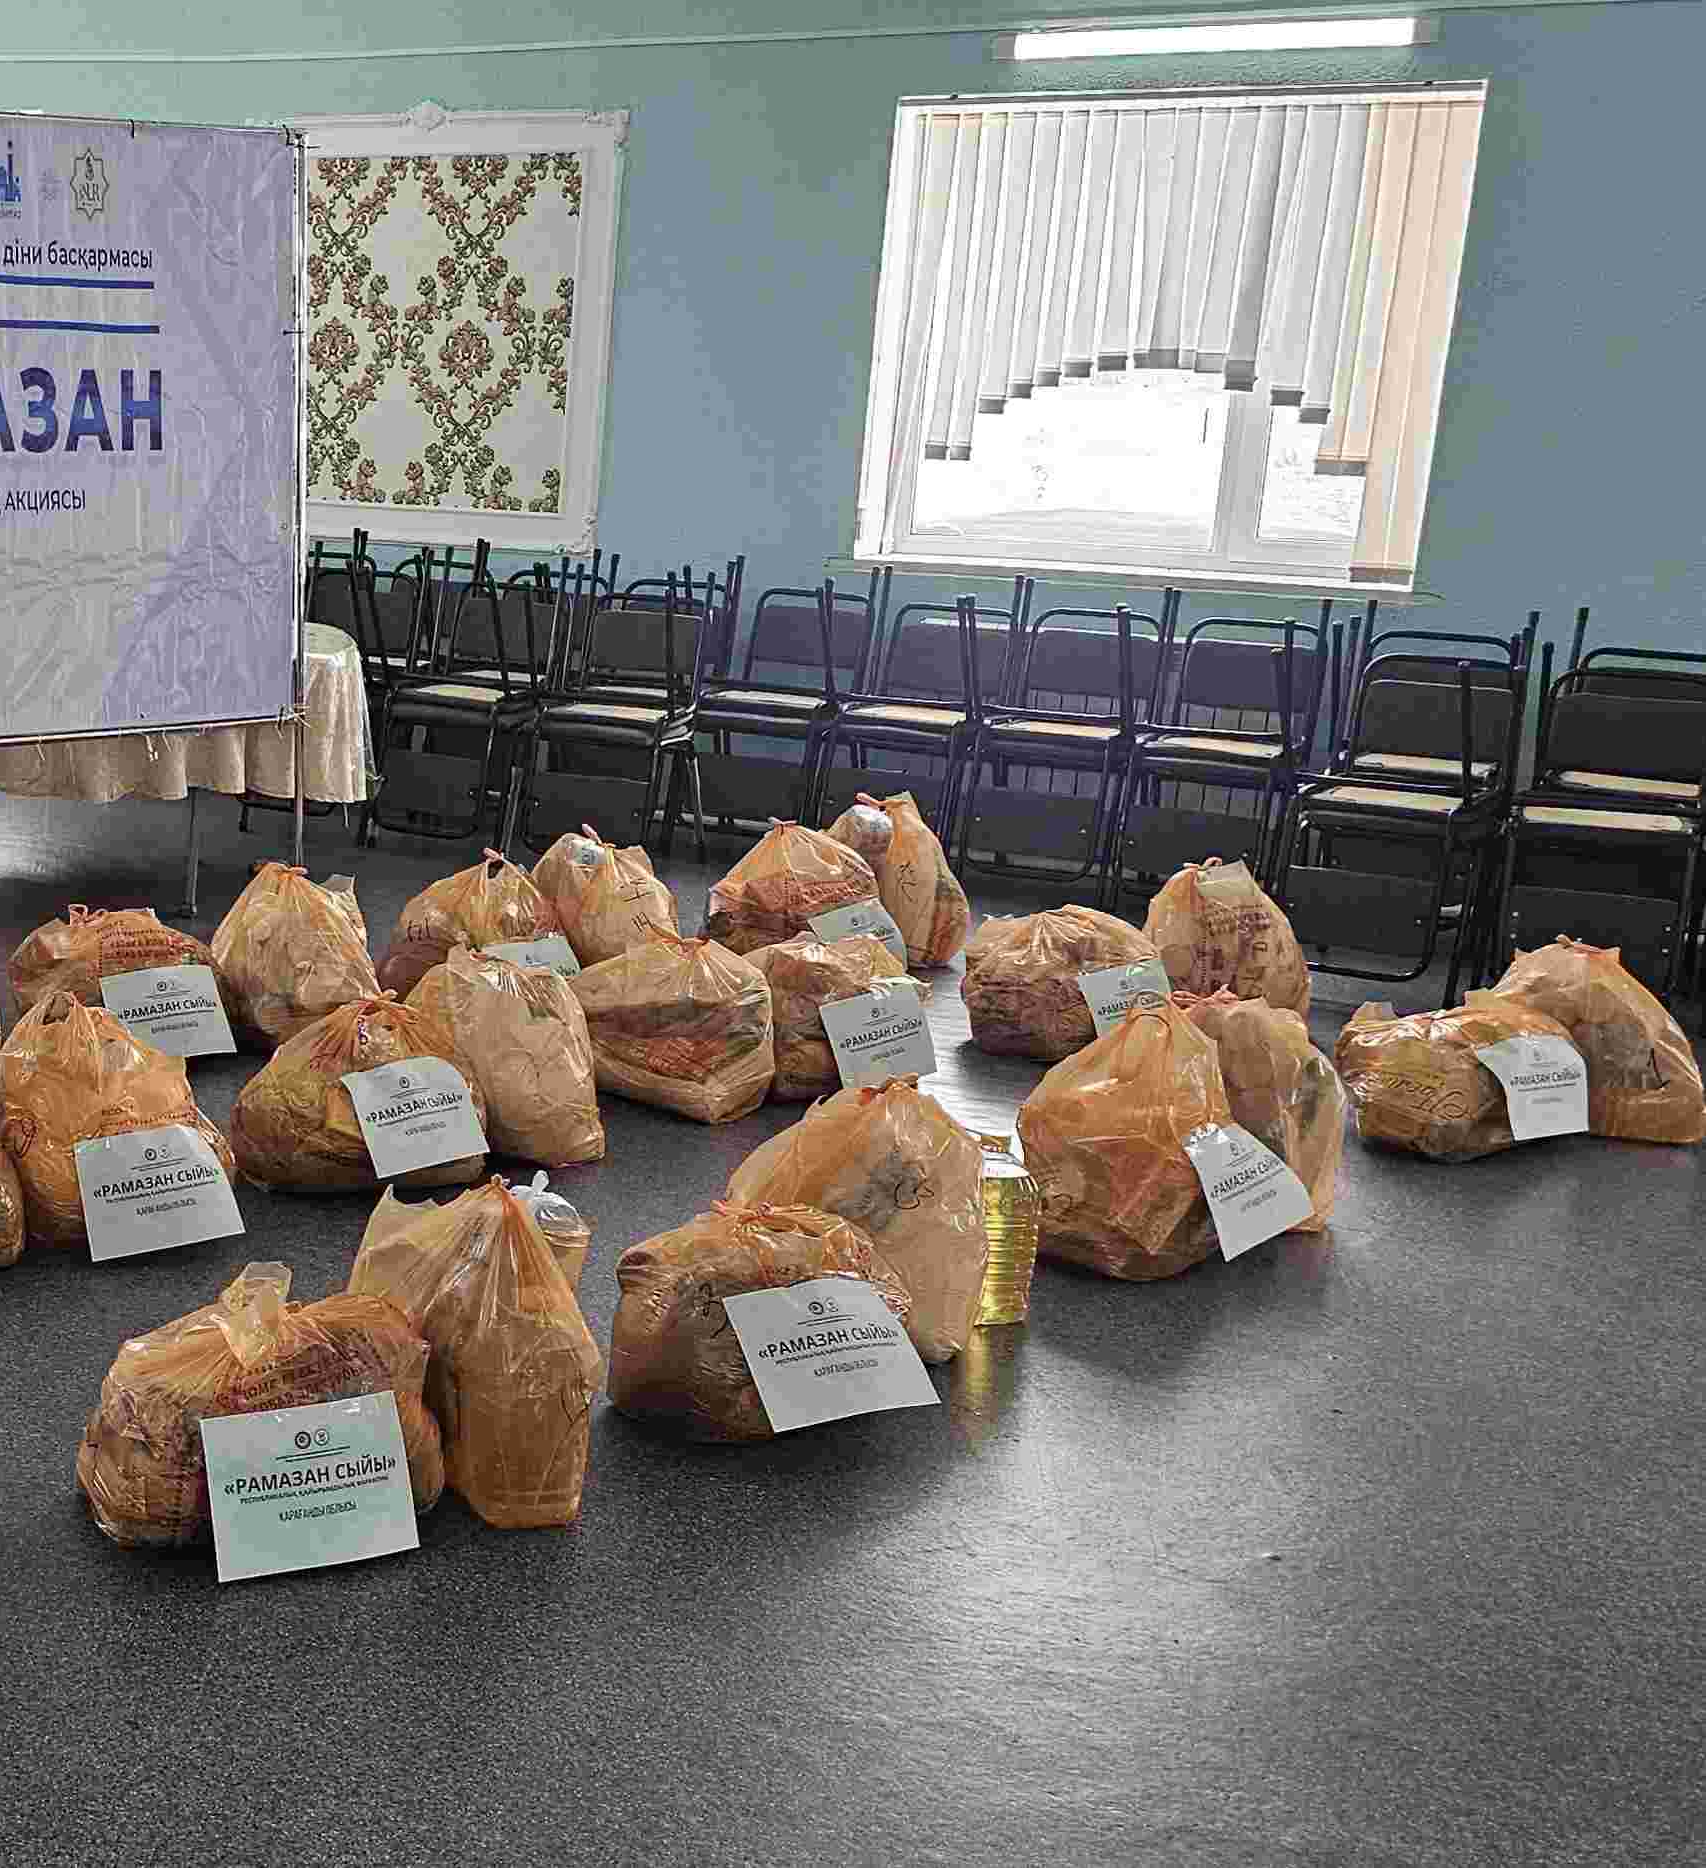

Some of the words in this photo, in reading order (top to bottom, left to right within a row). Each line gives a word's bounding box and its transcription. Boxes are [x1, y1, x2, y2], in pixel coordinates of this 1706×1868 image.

[3, 240, 42, 266] діни
[47, 240, 153, 273] басқармасы
[4, 489, 86, 515] АКЦИЯСЫ
[94, 1173, 174, 1199] «РАМАЗАН
[758, 1328, 849, 1359] «РАМАЗАН
[223, 1465, 330, 1496] «РАМАЗАН
[335, 1453, 397, 1481] СЫЙЫ»
